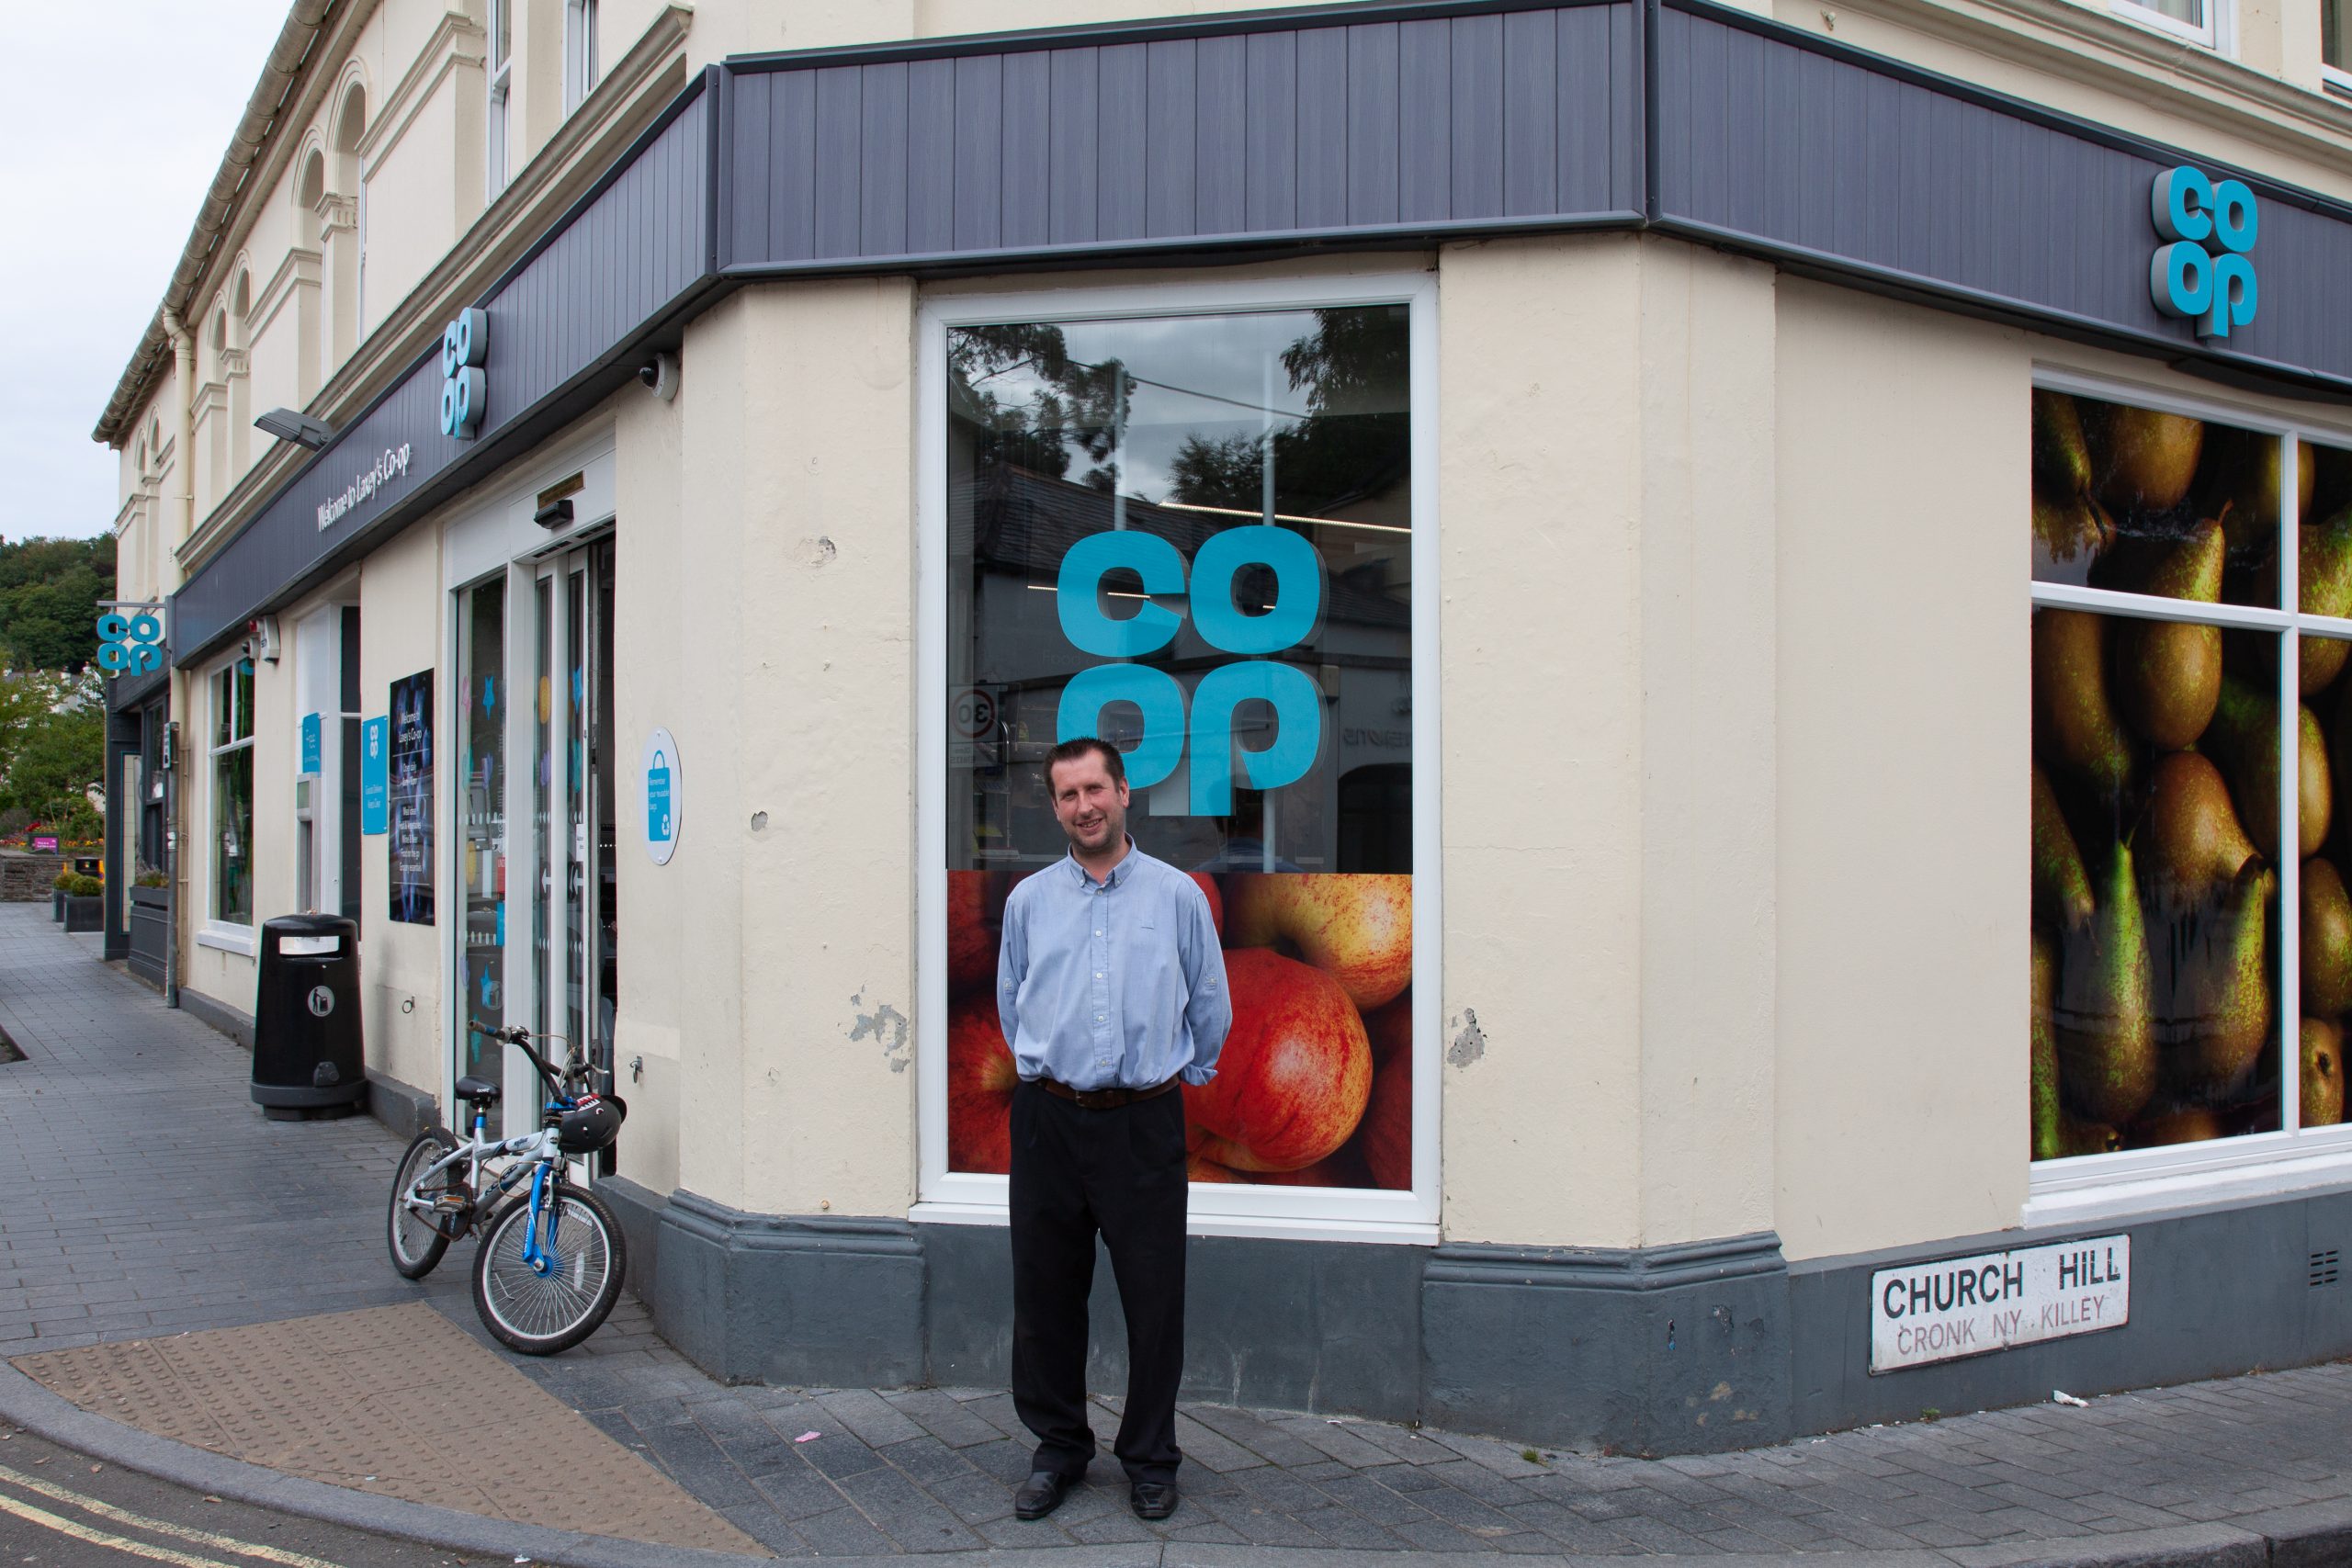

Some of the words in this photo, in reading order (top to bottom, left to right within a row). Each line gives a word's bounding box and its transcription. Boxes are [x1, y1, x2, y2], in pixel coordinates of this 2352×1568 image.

[318, 497, 347, 532] Welcome
[348, 485, 356, 509] to
[356, 457, 383, 502] Laxey's
[384, 443, 410, 480] Co-op
[411, 727, 423, 742] Co-op
[1883, 1262, 2023, 1319] CHURCH
[2059, 1247, 2120, 1290] HILL
[1897, 1318, 1975, 1356] CRONK
[1994, 1309, 2022, 1337] NY
[2041, 1295, 2107, 1328] KILLEY
